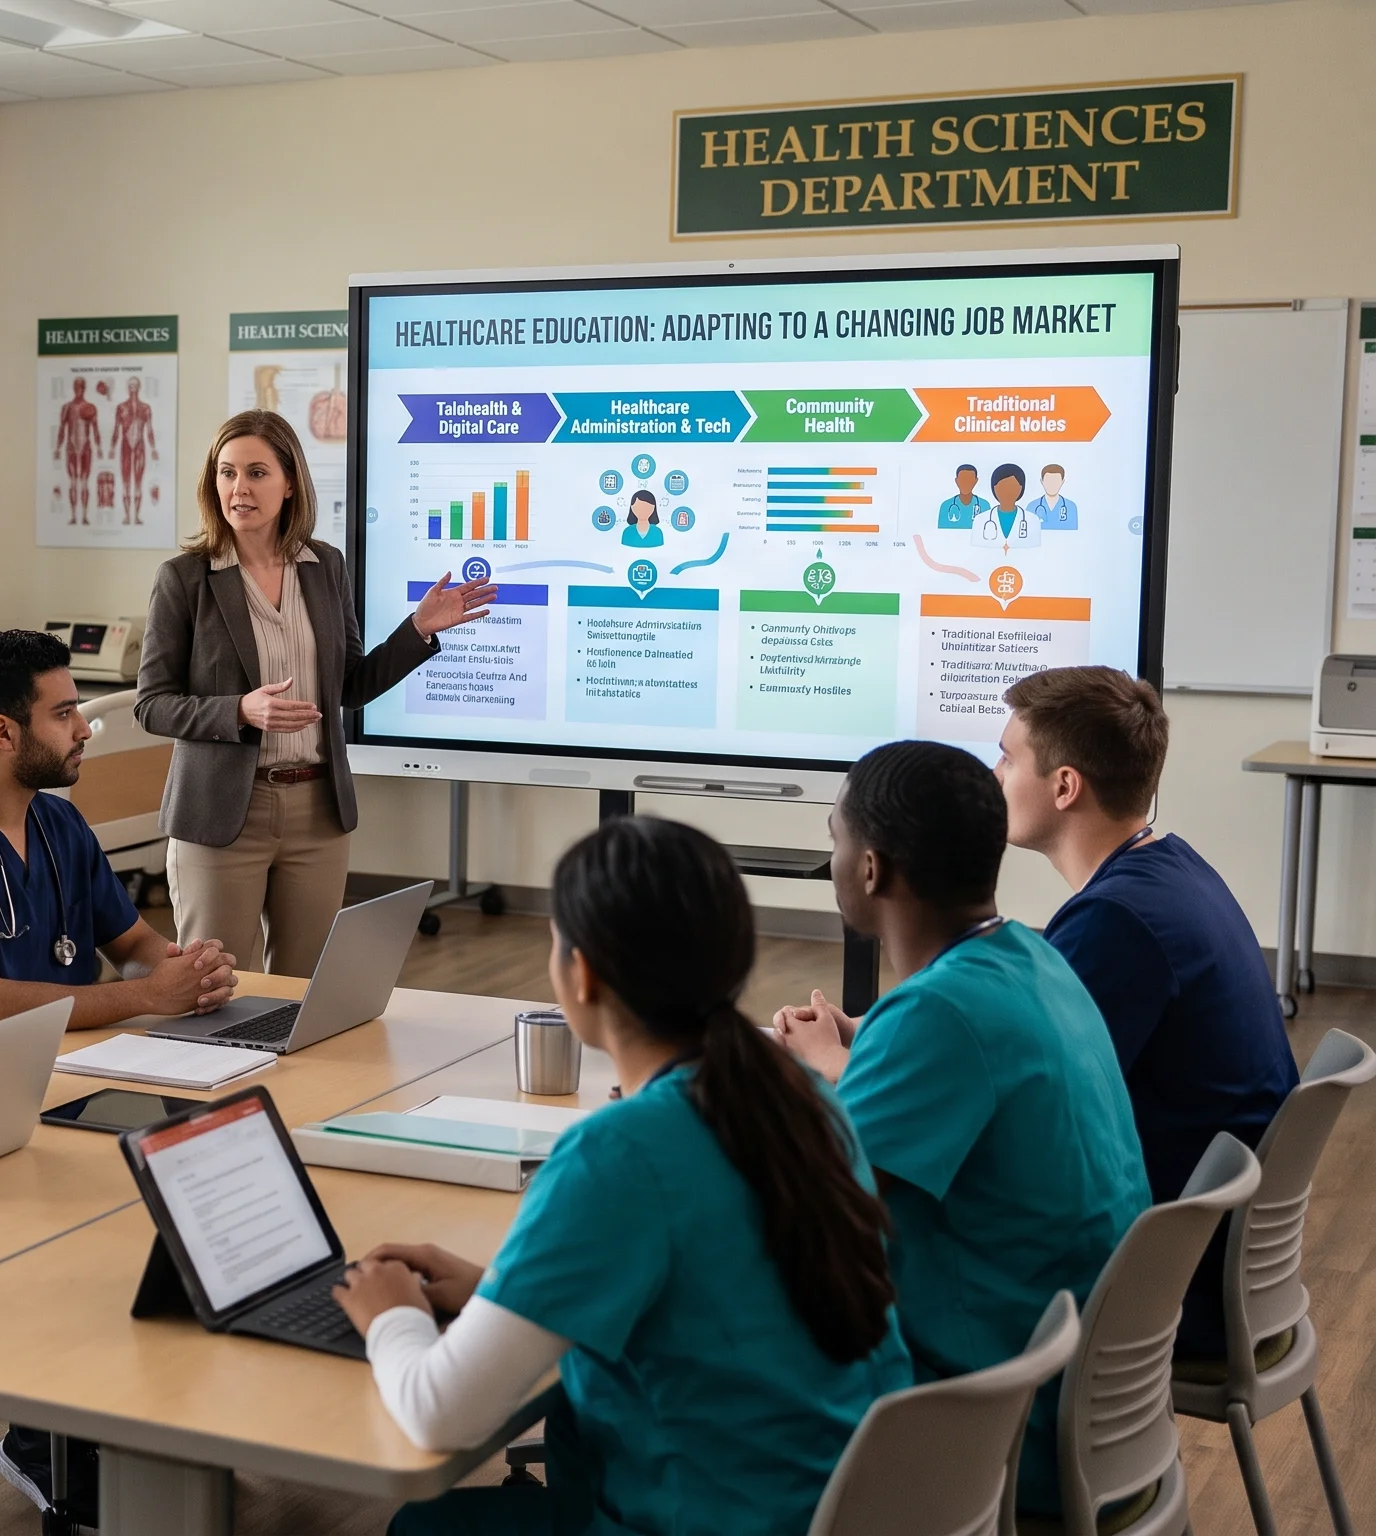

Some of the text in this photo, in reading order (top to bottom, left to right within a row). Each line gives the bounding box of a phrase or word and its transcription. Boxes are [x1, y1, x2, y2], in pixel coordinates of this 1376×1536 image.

[700, 101, 1208, 168] HEALTH SCIENCES
[760, 160, 1140, 217] DEPARTMENT
[238, 324, 296, 339] HEALTH
[395, 303, 1117, 347] HEALTHCARE EDUCATION: ADAPTING TO A CHANGING JOB MARKET
[45, 328, 170, 344] HEALTH SCIENCES
[511, 401, 522, 416] &
[610, 399, 690, 415] Healthcare
[785, 397, 875, 418] Community
[966, 394, 1055, 412] Traditional
[438, 420, 520, 439] Digital Care
[570, 417, 731, 434] Administration & Tech
[804, 417, 855, 433] Health
[954, 416, 1015, 433] Clinical
[942, 629, 995, 640] Traditional
[509, 672, 527, 682] And
